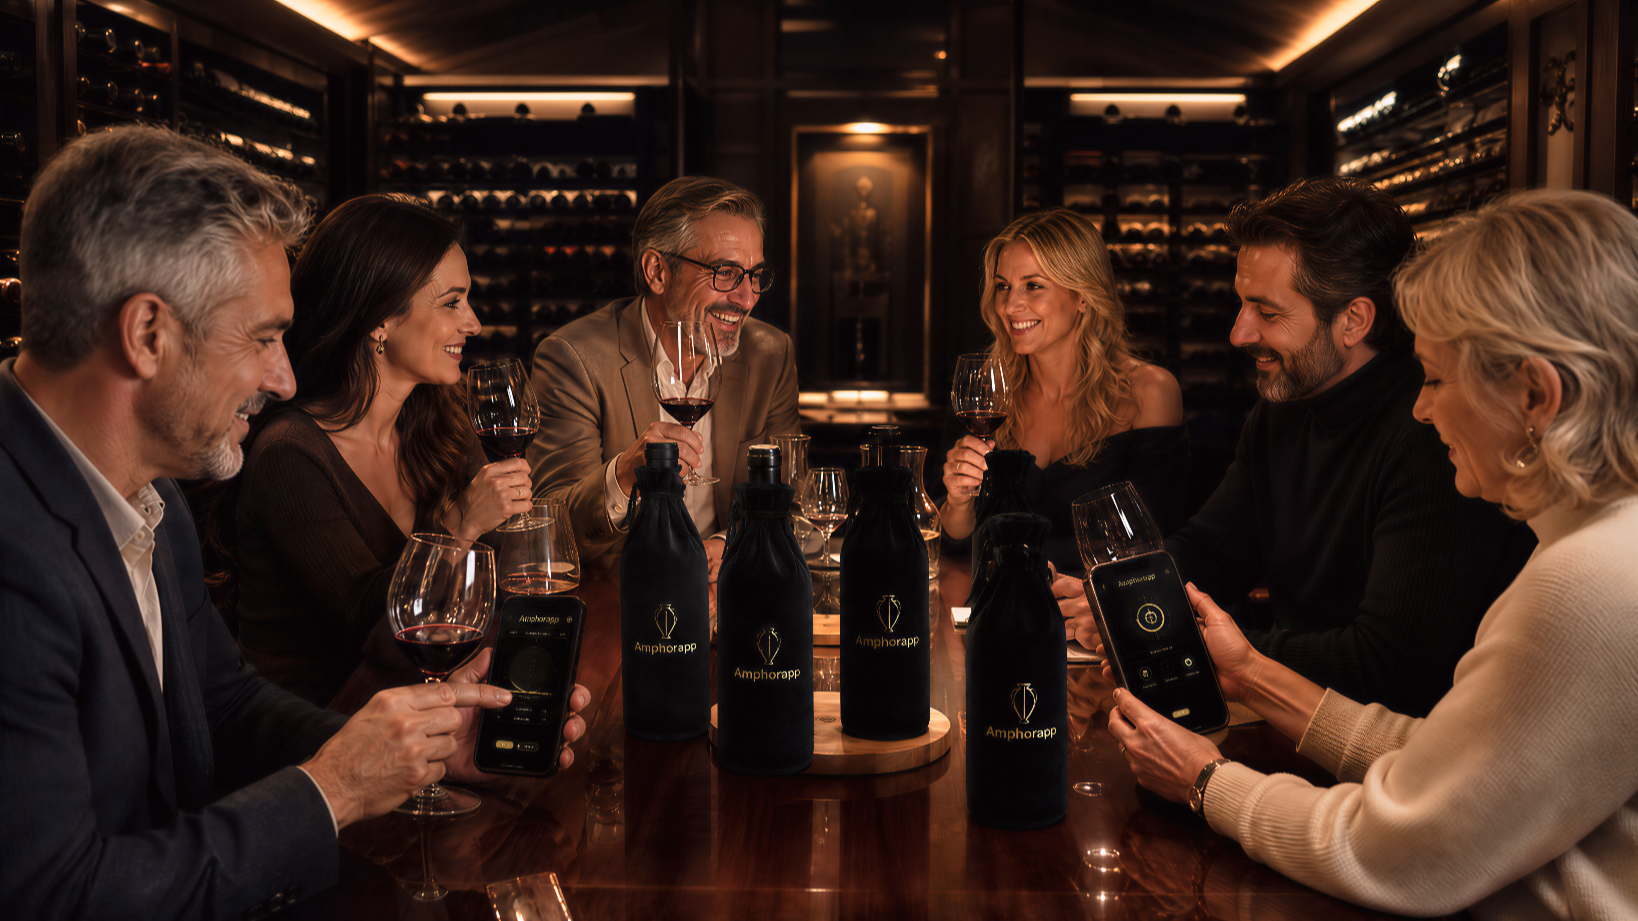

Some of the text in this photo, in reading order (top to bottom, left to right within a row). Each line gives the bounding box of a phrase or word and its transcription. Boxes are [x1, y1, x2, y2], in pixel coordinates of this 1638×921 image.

[634, 641, 697, 656] Amphorapp
[855, 634, 920, 650] Amphorapp
[734, 666, 801, 683] Amphorapp
[985, 725, 1057, 742] Amphorapp
